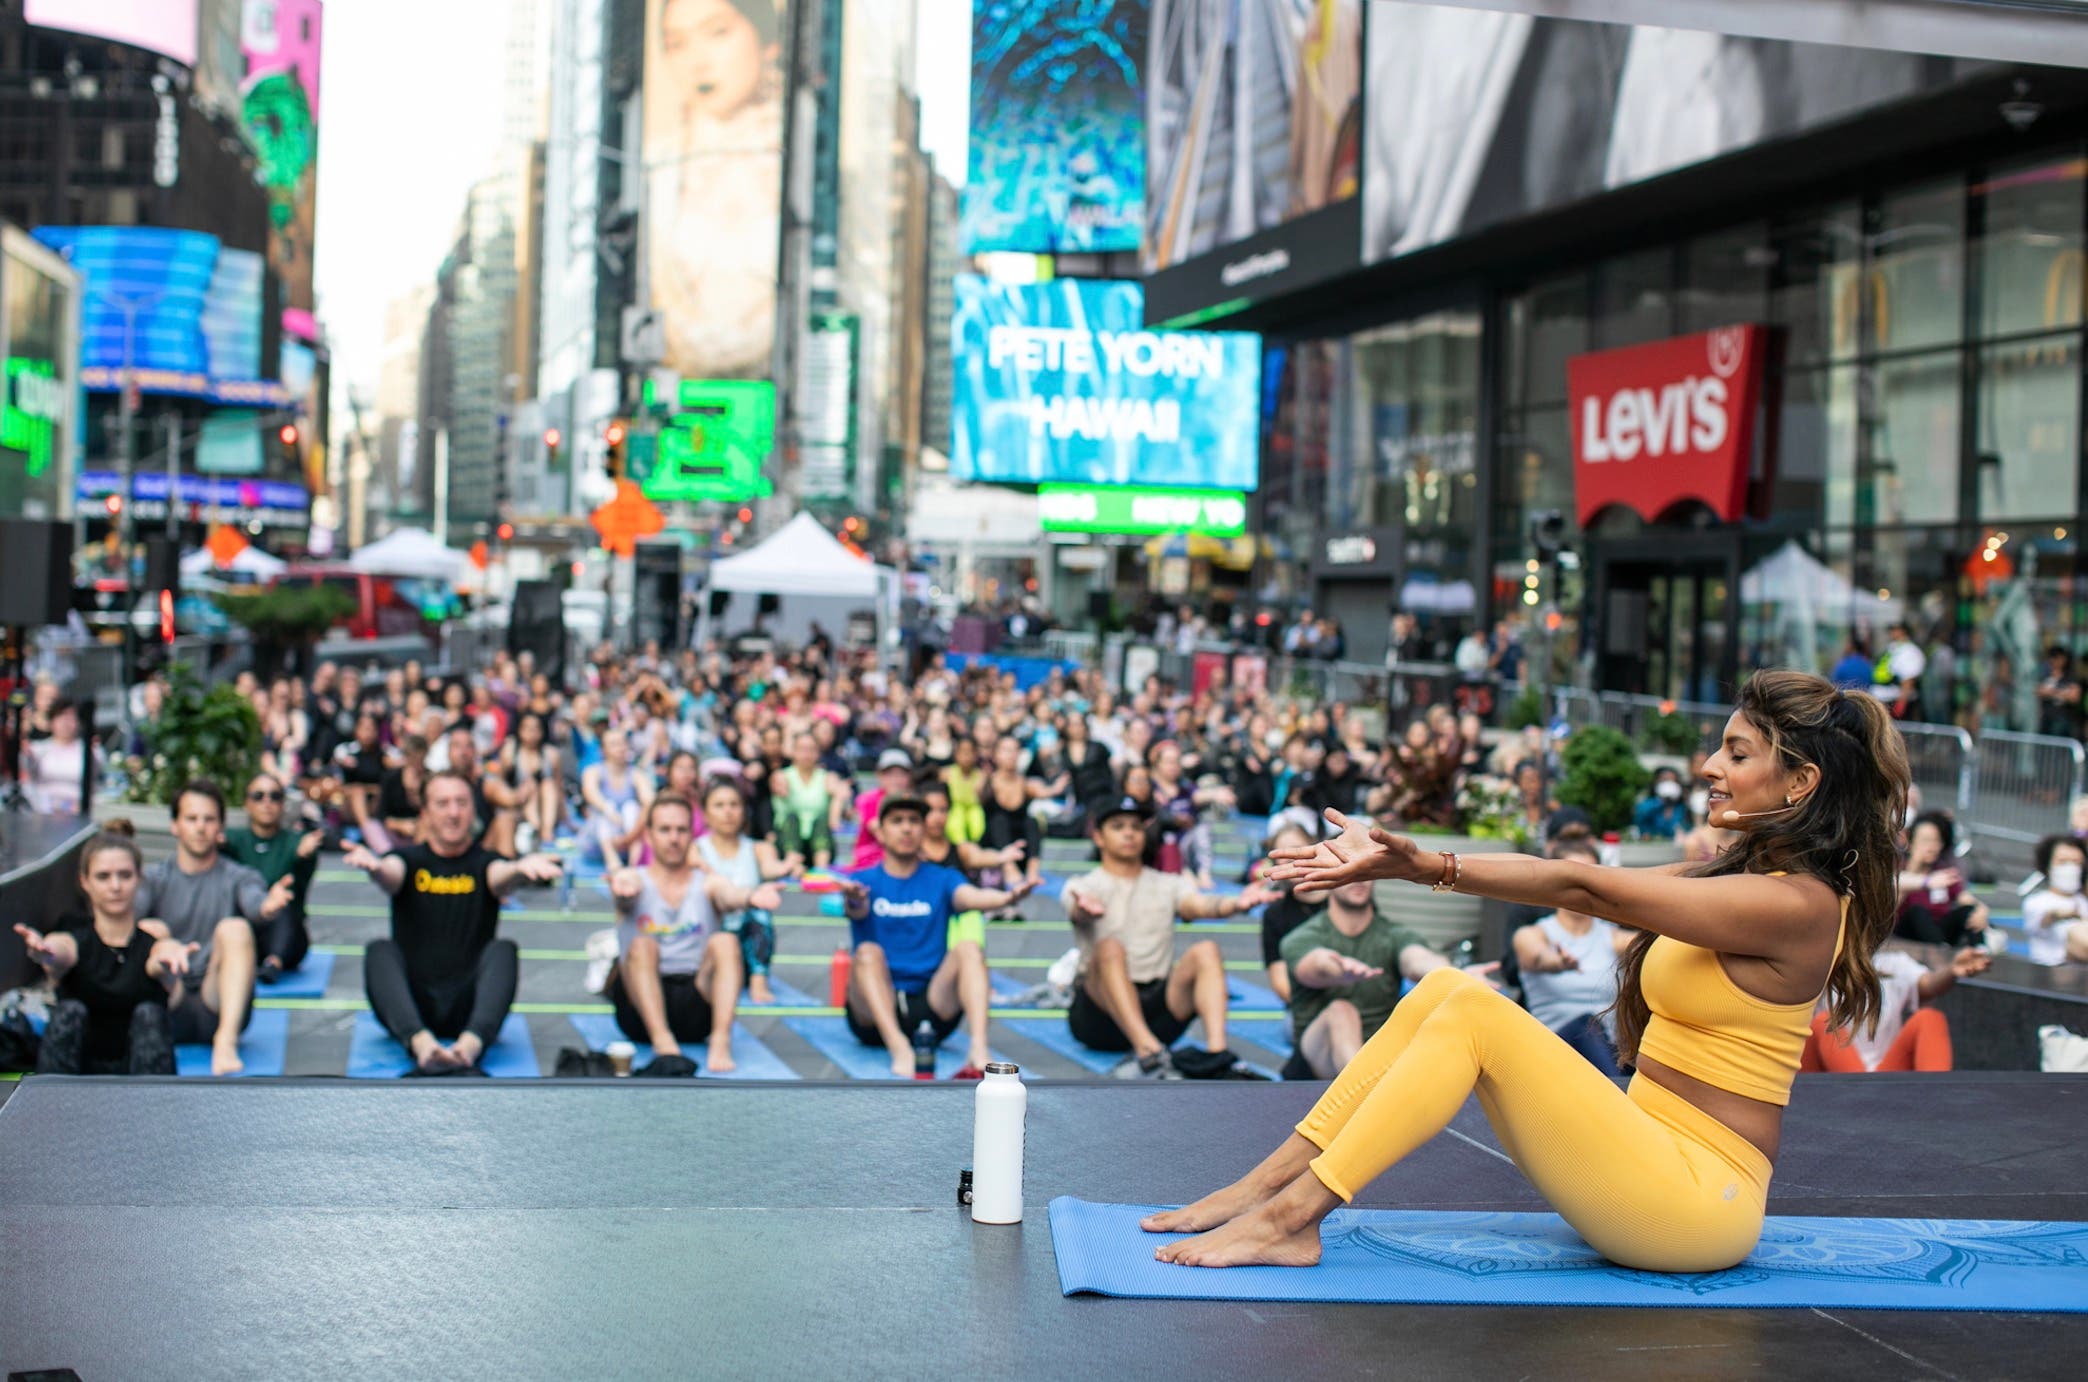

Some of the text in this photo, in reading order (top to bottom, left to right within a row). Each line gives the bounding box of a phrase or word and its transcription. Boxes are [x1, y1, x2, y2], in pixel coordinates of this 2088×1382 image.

[988, 325, 1223, 379] PETE YORN
[1030, 394, 1181, 443] HAWAII
